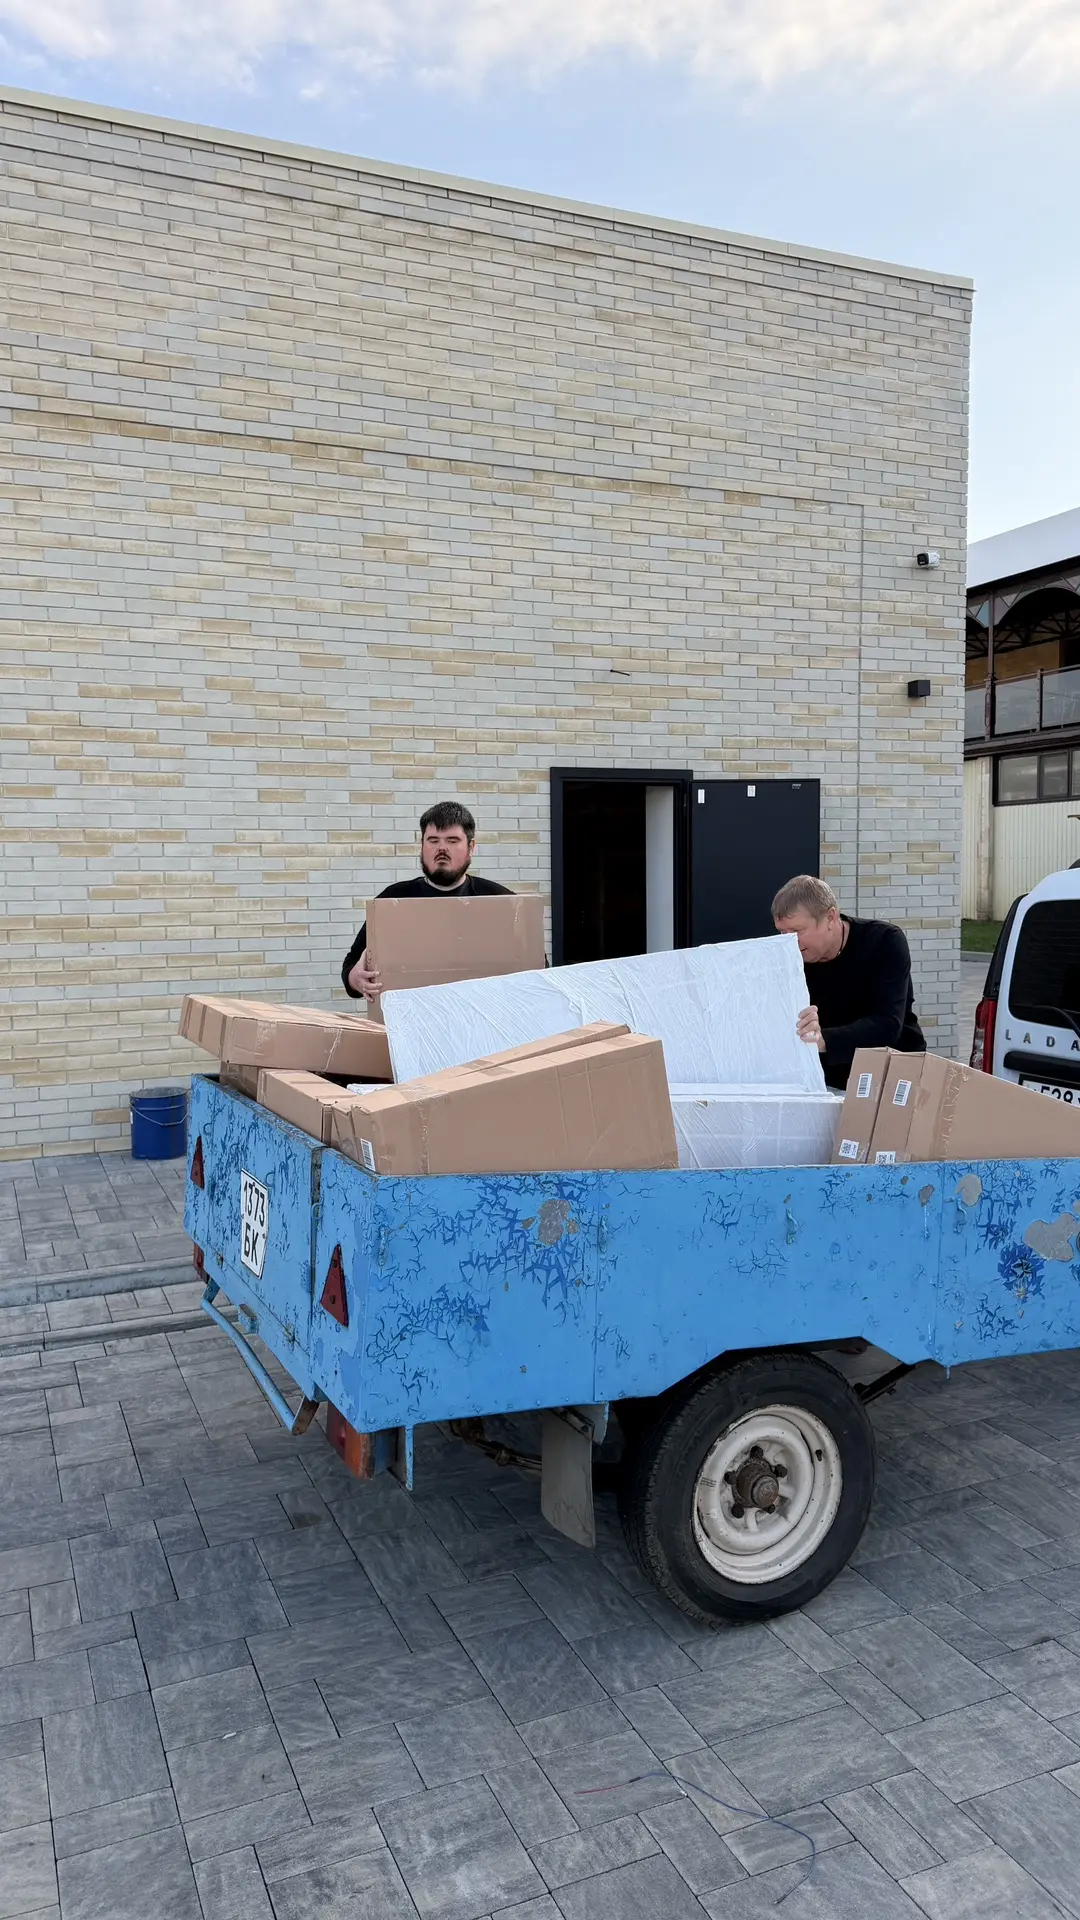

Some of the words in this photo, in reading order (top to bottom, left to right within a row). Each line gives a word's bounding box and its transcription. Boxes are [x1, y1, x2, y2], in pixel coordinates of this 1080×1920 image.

[1005, 1029, 1080, 1051] LADA
[243, 1181, 265, 1227] 1373
[243, 1222, 259, 1266] БК
